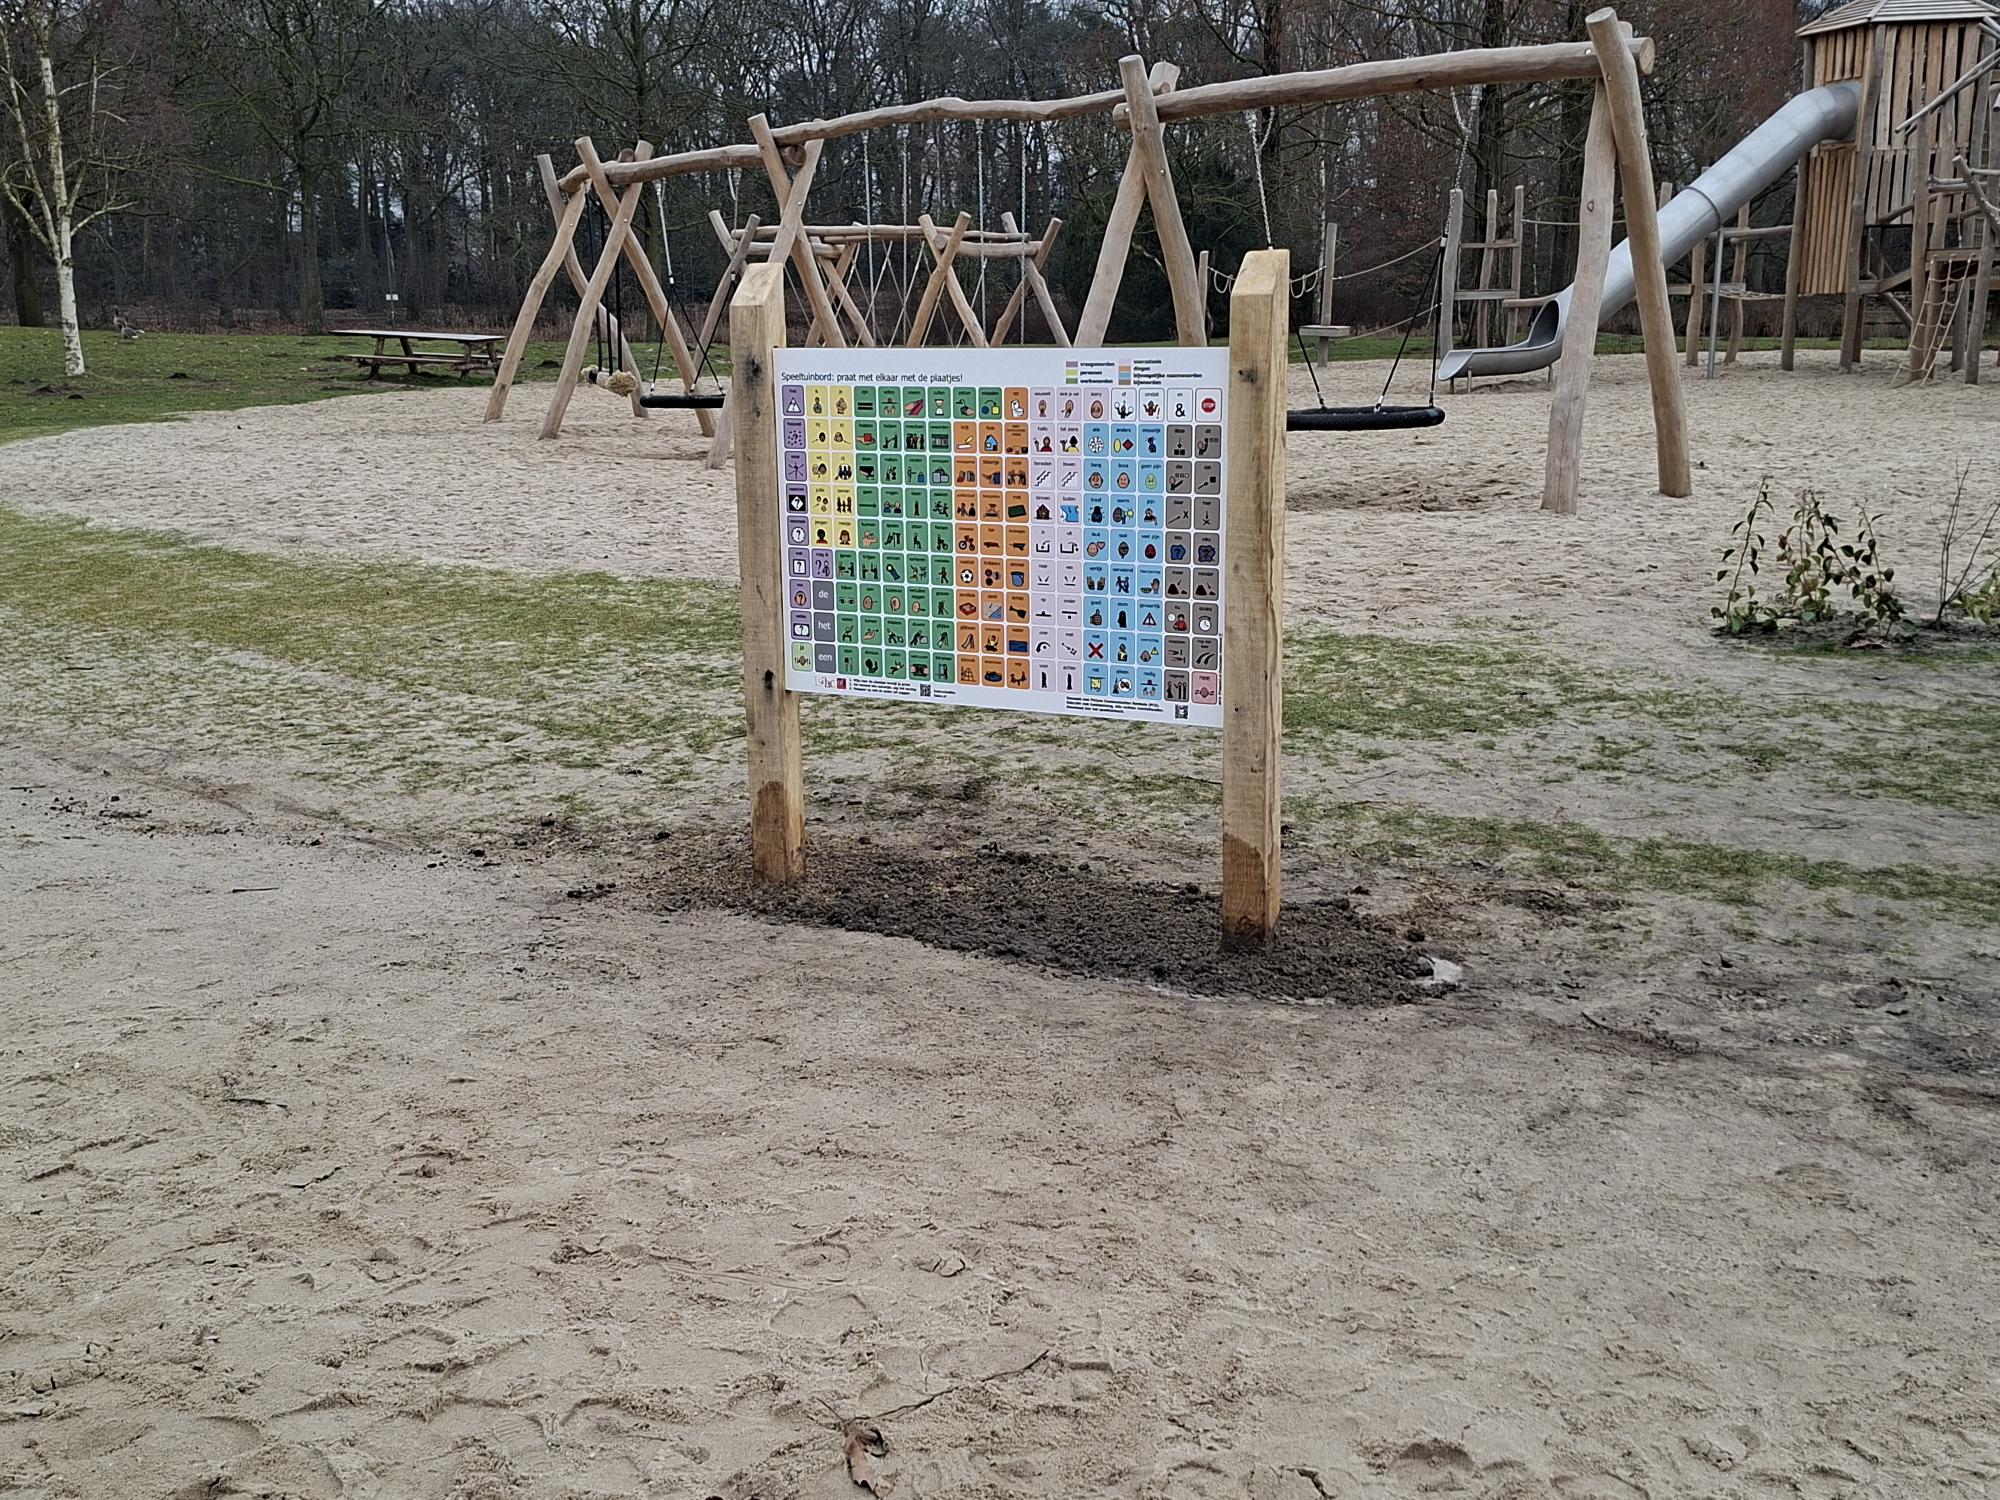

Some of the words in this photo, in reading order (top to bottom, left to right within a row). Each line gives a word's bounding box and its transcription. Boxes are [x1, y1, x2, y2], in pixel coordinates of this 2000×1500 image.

[781, 372, 834, 382] Speeltuinbord:
[837, 374, 856, 383] praat
[859, 374, 873, 382] met
[876, 373, 898, 382] elkaar
[901, 374, 916, 382] met
[917, 374, 928, 382] de
[930, 373, 963, 384] plaatjes!
[818, 590, 828, 598] de
[818, 621, 831, 630] het
